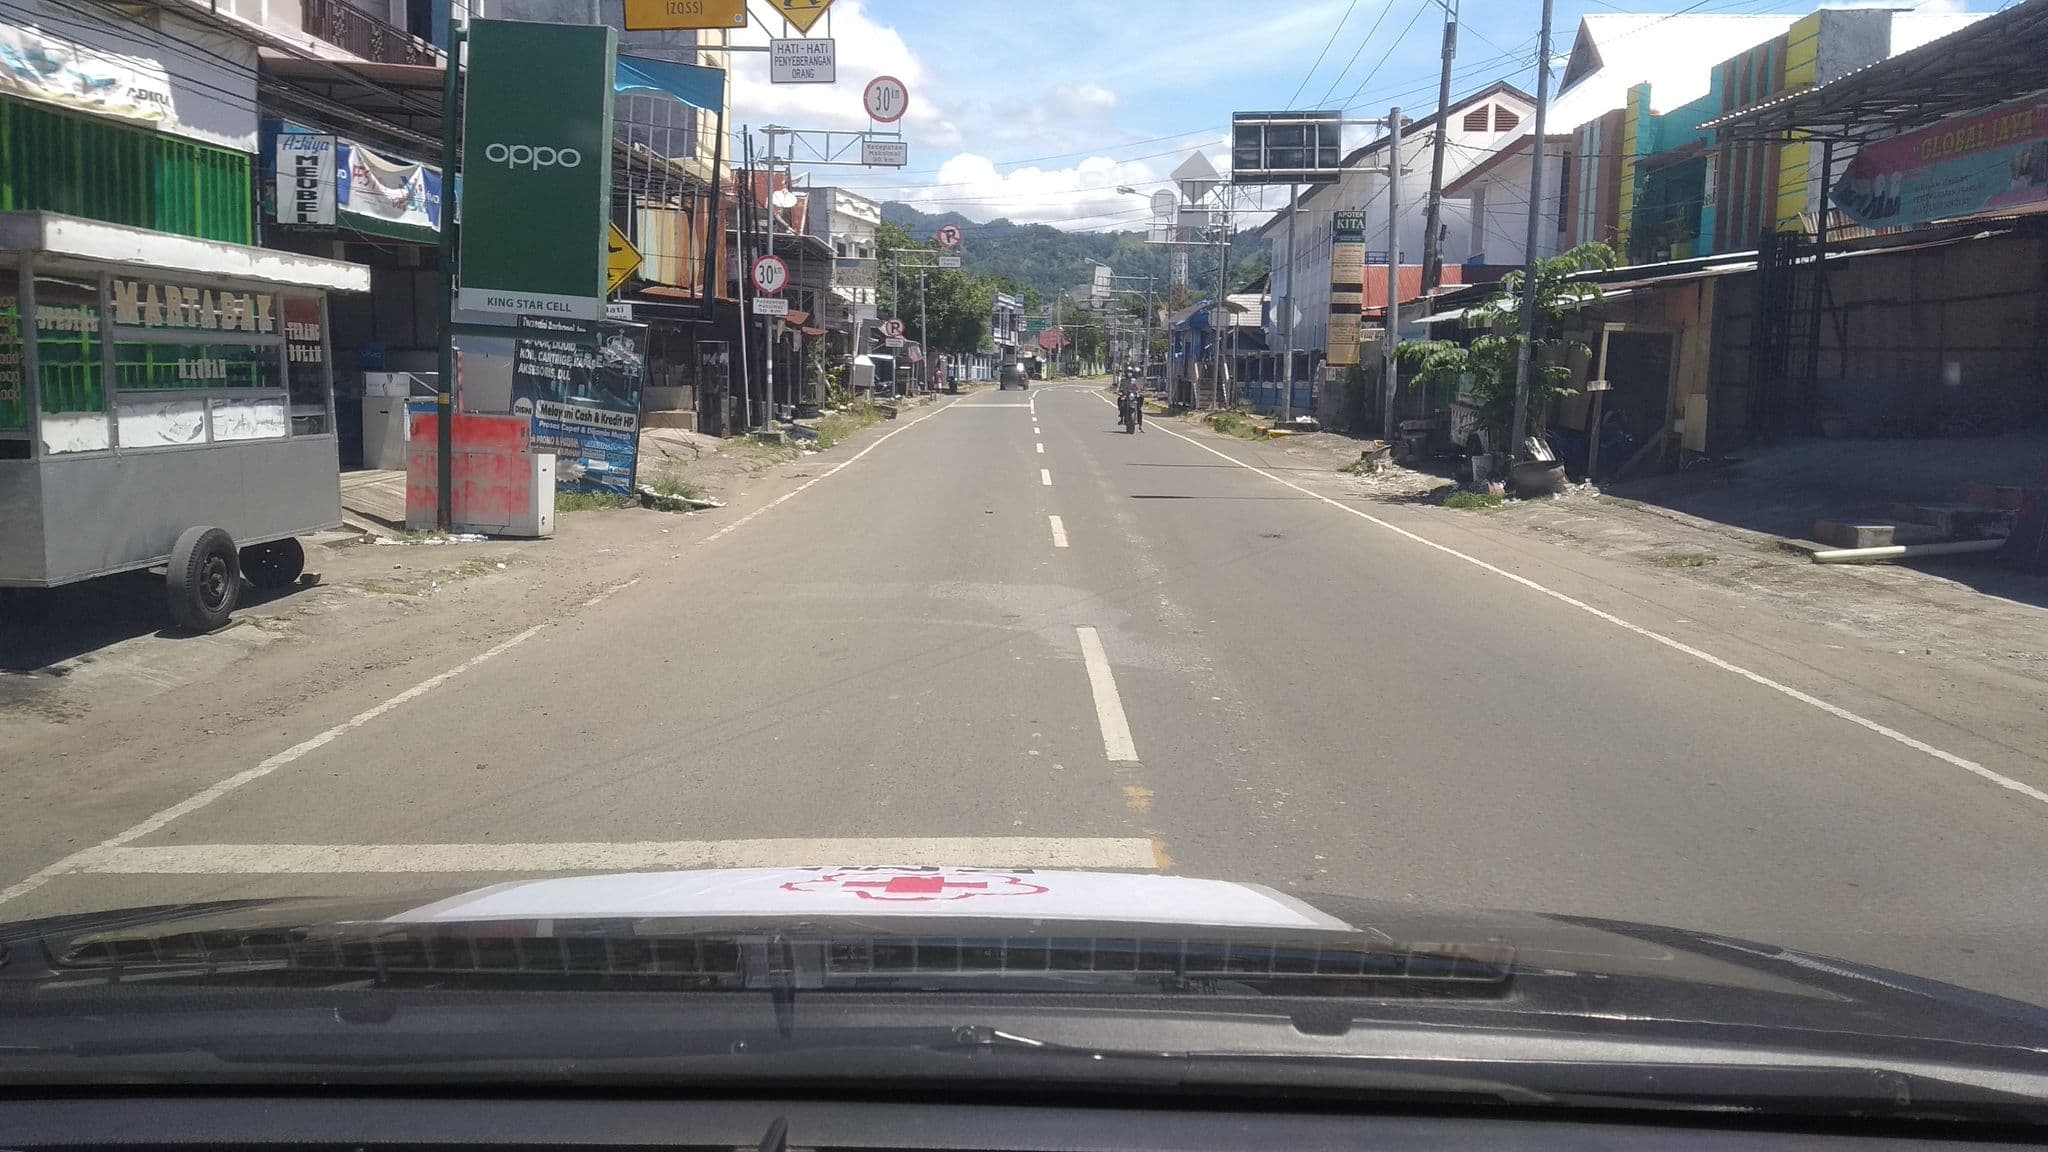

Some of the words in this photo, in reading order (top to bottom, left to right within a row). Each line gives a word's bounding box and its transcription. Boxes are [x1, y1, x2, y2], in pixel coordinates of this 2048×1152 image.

[666, 1, 703, 15] (ZOSS)
[774, 56, 832, 66] PENYEBERANGAN
[791, 69, 815, 79] ORANG
[875, 86, 890, 112] 30
[282, 136, 331, 154] Azkiya
[296, 155, 318, 224] MEUBEL
[1337, 219, 1364, 228] KITA
[759, 264, 773, 284] 30
[113, 280, 272, 332] MARTABAK
[487, 297, 514, 307] KING
[517, 299, 543, 310] STAR
[546, 302, 572, 312] CELL
[288, 343, 323, 363] BULAN
[538, 420, 560, 429] Proses
[575, 409, 592, 422] Cash
[594, 412, 600, 420] &
[601, 413, 623, 427] Kredit
[624, 416, 635, 427] HP
